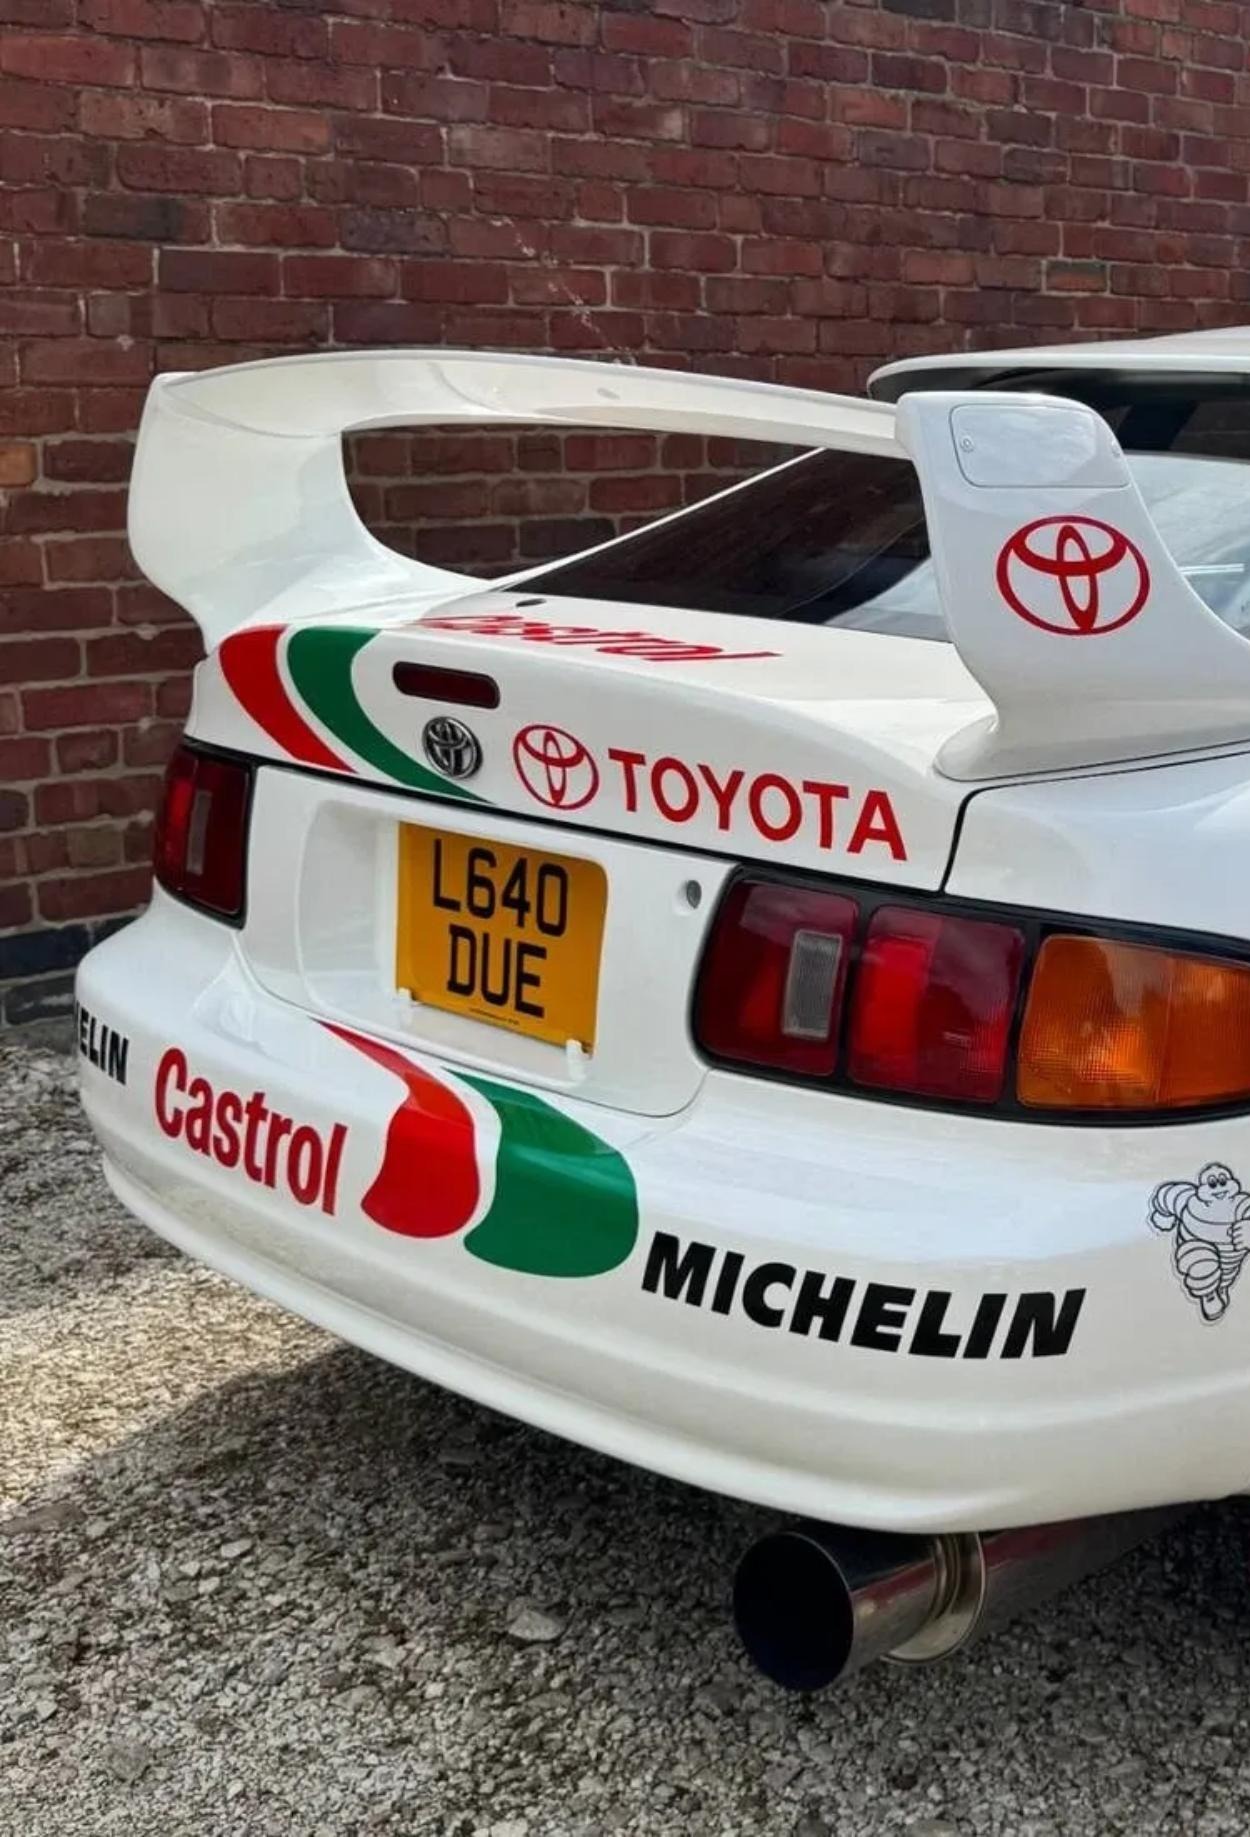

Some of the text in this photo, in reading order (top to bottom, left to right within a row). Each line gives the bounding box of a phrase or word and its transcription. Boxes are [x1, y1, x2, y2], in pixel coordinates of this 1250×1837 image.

[608, 748, 907, 861] TOYOTA
[432, 838, 568, 937] L640
[447, 925, 547, 1019] DUE
[77, 1002, 129, 1086] ELIN
[154, 1048, 347, 1216] Castrol
[641, 1231, 1086, 1359] MICHELIN
